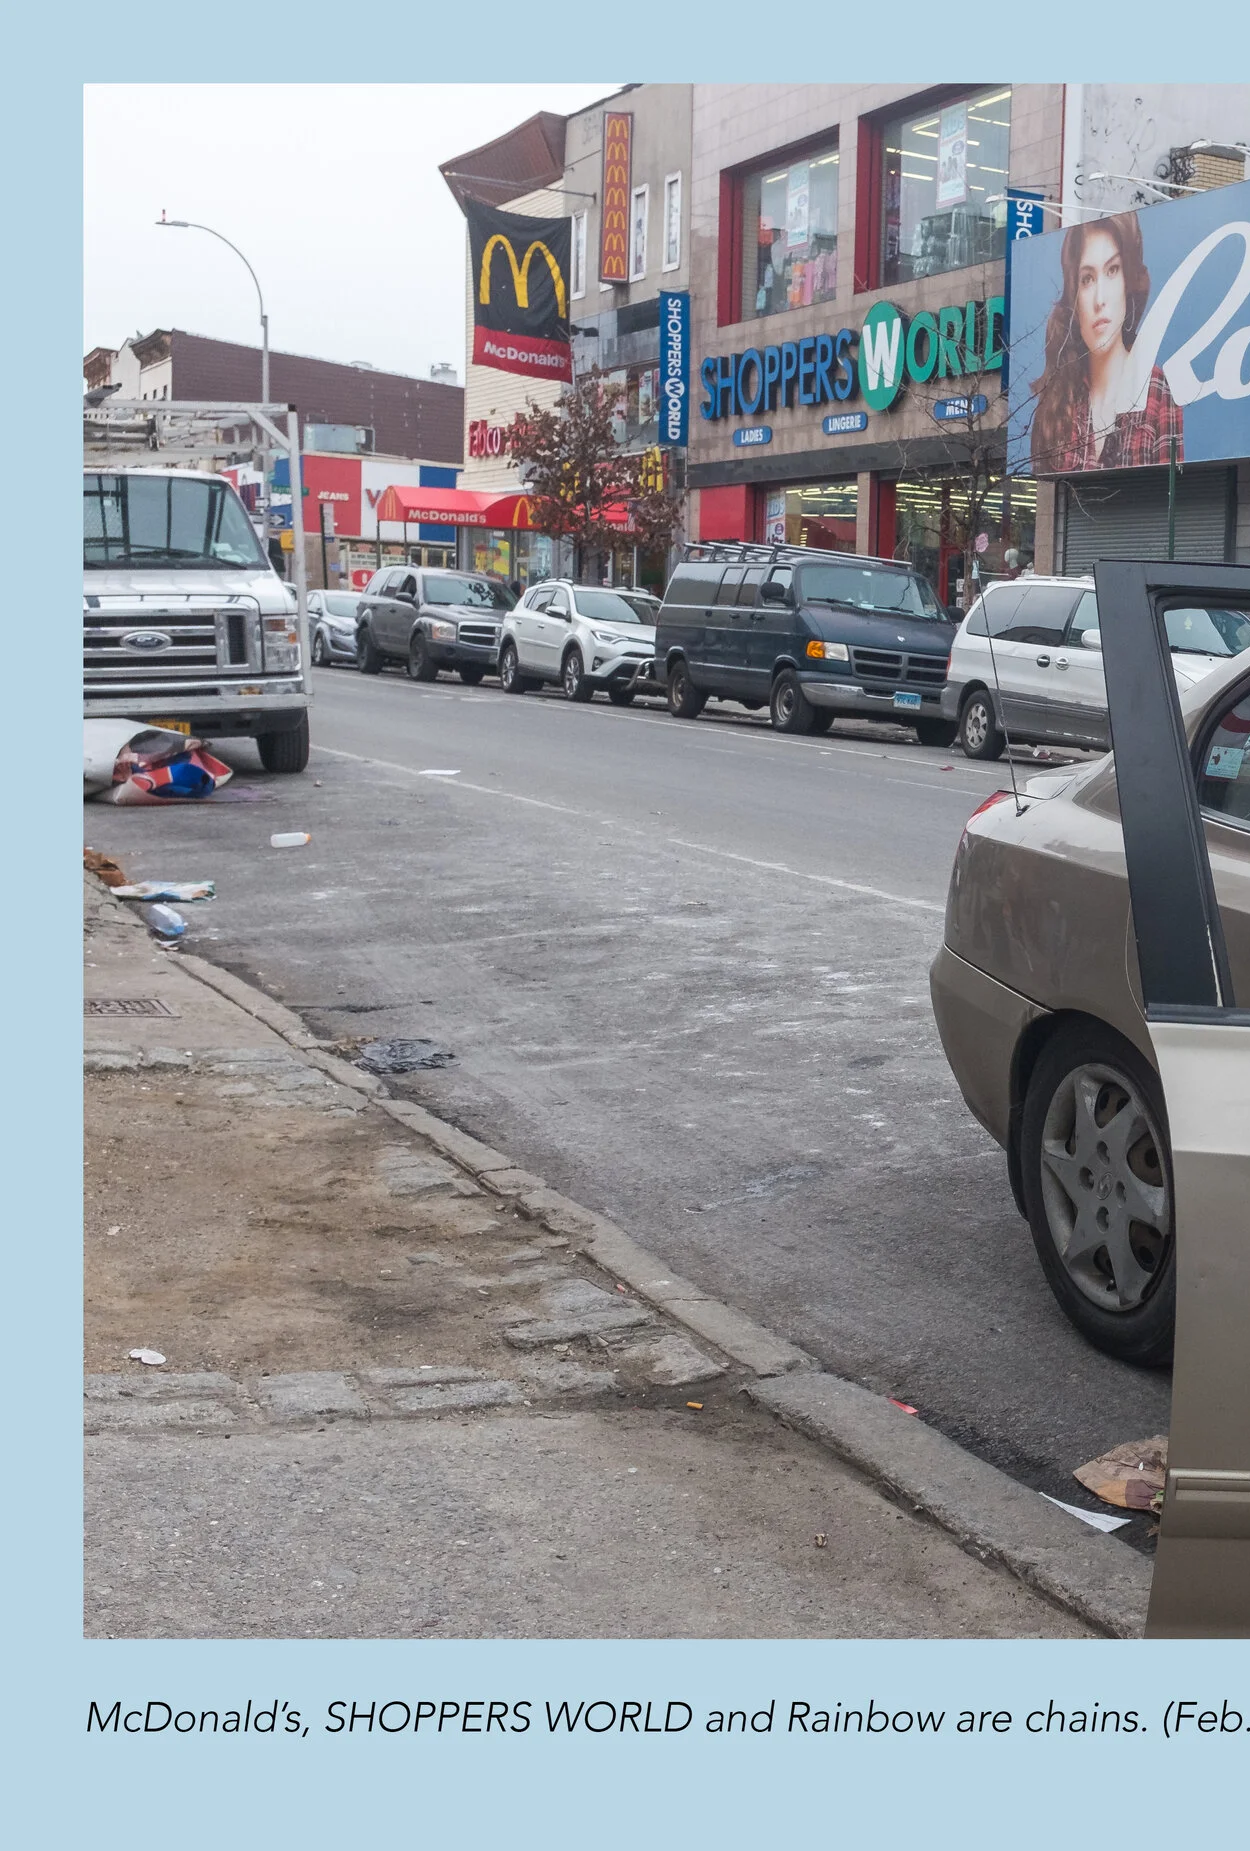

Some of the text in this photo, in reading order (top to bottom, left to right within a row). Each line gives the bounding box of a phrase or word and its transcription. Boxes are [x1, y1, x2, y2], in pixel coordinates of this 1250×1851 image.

[484, 341, 567, 368] McDonald's
[700, 296, 1004, 421] SHOPPERS WORLD
[666, 298, 683, 440] SHOPPERS WORLD
[946, 400, 974, 416] MEN
[828, 415, 861, 432] LINGERIE
[741, 427, 763, 444] LADIES
[317, 491, 349, 501] JEANS
[408, 509, 487, 524] McDonald's
